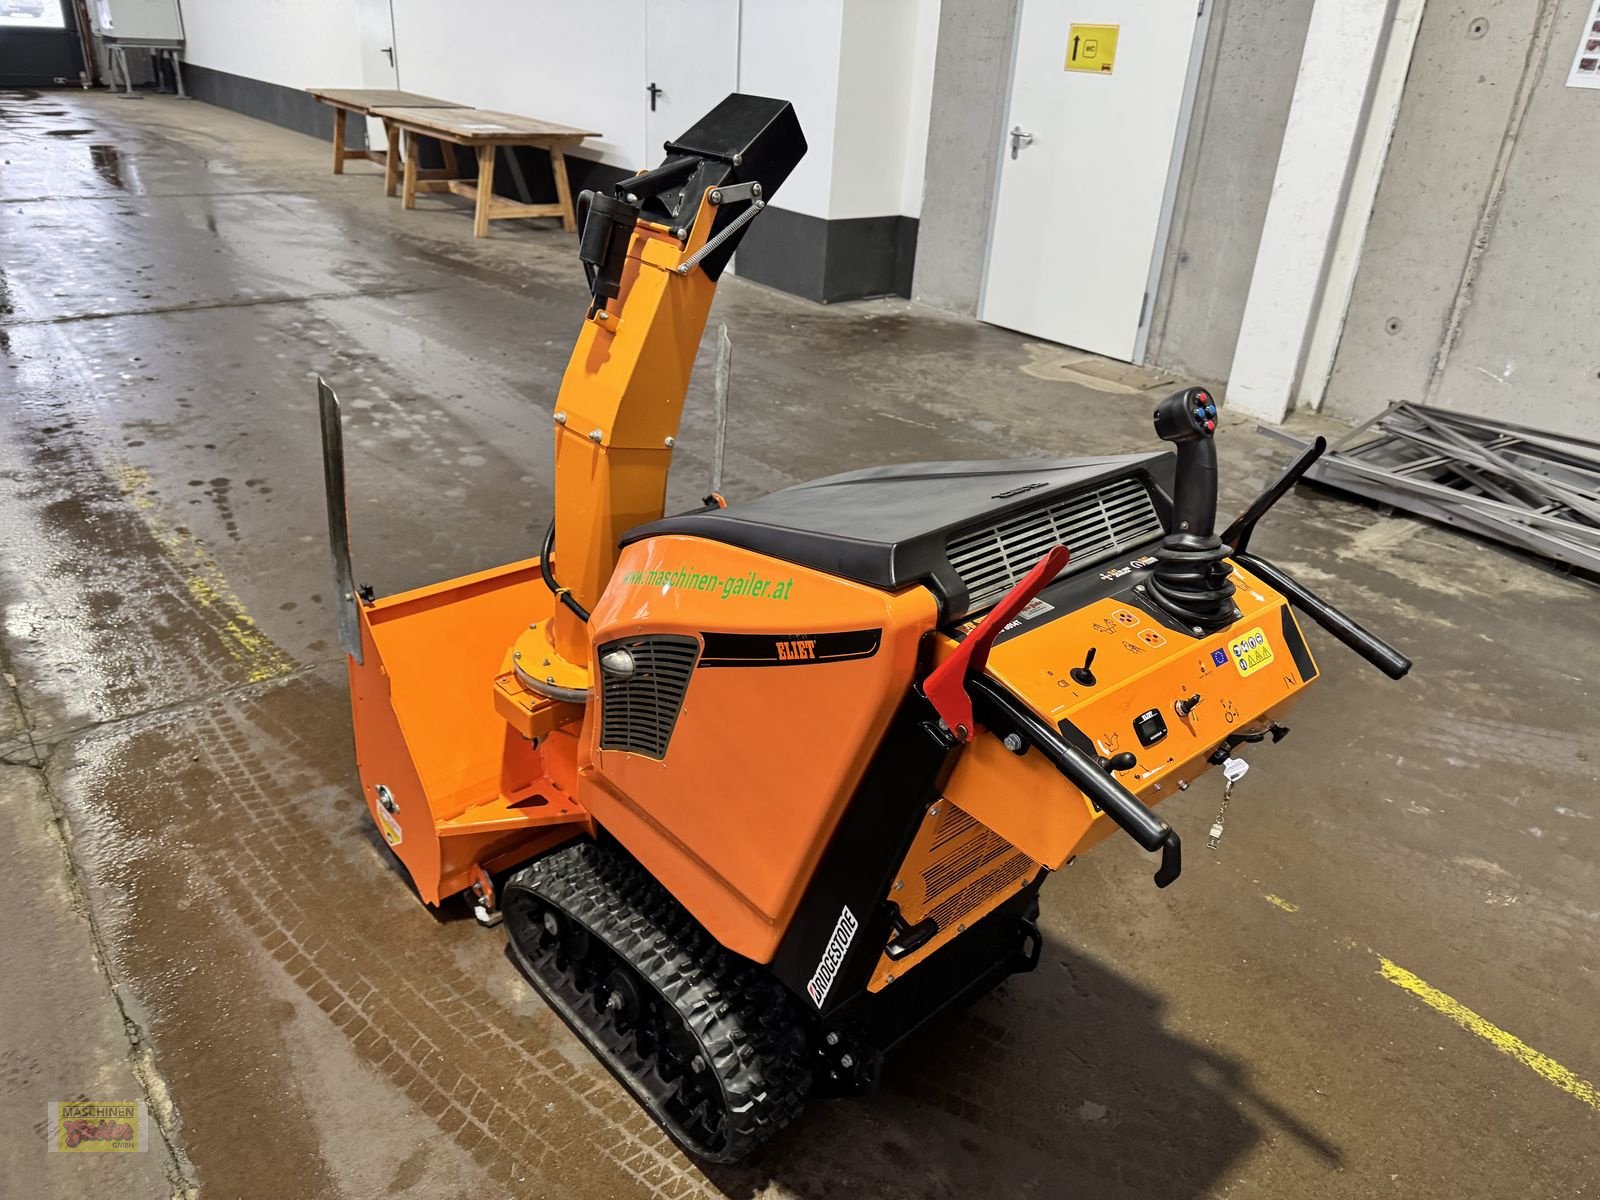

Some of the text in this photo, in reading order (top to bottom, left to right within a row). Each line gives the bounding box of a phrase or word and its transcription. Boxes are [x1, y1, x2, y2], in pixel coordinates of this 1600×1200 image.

[622, 565, 794, 601] www.maschinen-gailer.at
[776, 640, 816, 660] ELIET
[809, 908, 856, 1002] BRIDGESTONE
